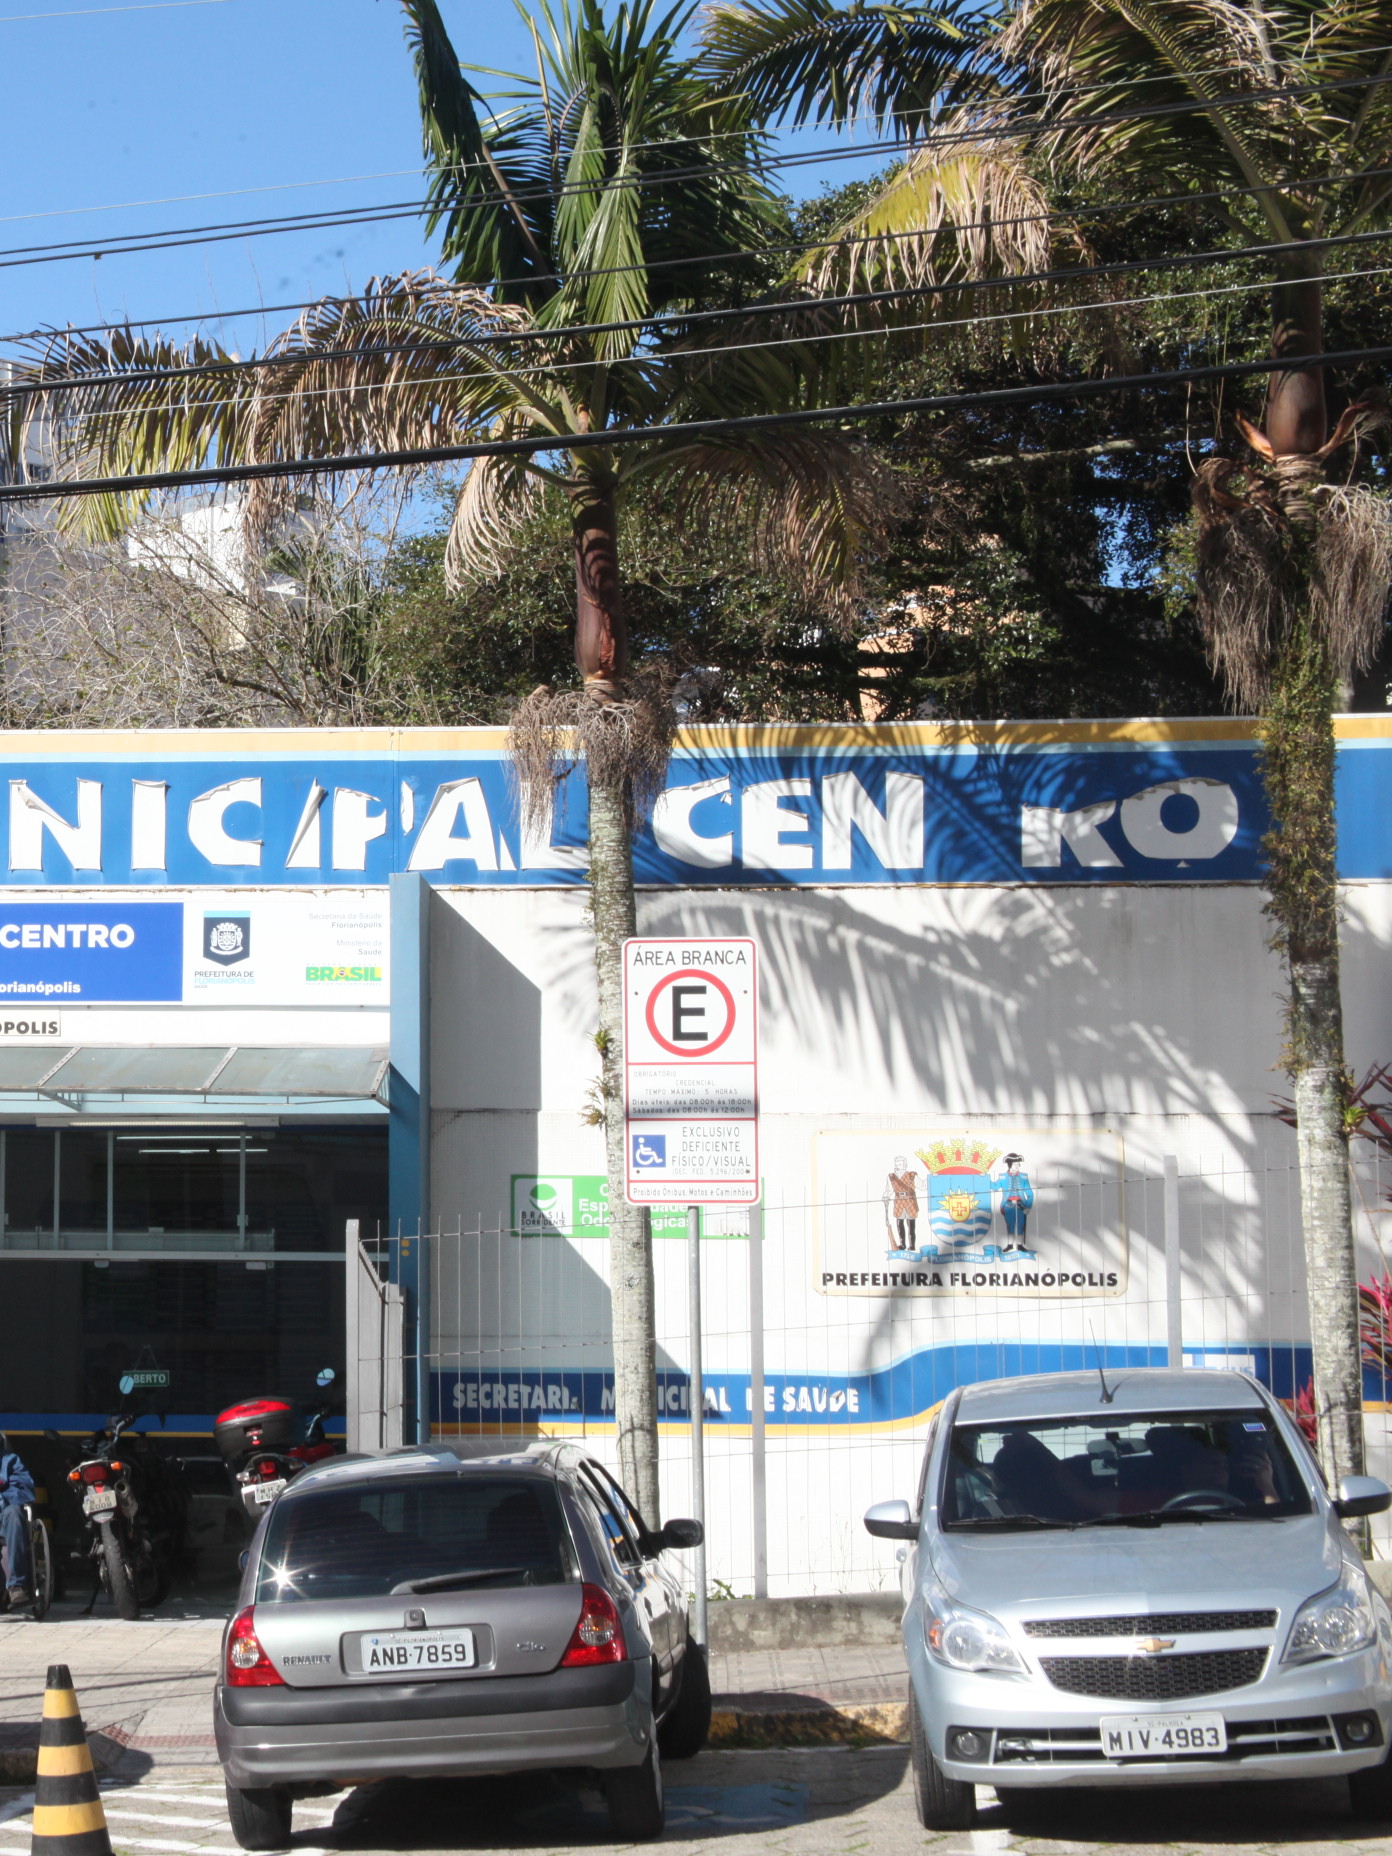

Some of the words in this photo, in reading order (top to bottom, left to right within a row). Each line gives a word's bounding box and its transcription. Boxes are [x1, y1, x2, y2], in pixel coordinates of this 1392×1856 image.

[652, 770, 1239, 870] CENRO
[331, 921, 383, 929] Florianópolis
[633, 945, 676, 966] ÁREA
[681, 950, 747, 966] BRANCA
[194, 970, 242, 978] PREFEITURA
[243, 970, 255, 978] DE
[305, 966, 382, 982] BRASIL
[672, 985, 708, 1041] E
[682, 1126, 740, 1138] EXCLUSIVO
[682, 1141, 741, 1152] DEFICIENTE
[672, 1153, 751, 1167] FÍSICO/VISUAL
[633, 1187, 661, 1197] Proibido
[689, 1187, 708, 1196] Motos
[715, 1187, 753, 1197] Caminhões
[521, 1211, 566, 1219] BRASIL
[822, 1271, 943, 1287] PREFEITURA
[949, 1267, 1119, 1287] FLORIANÓPOLIS
[127, 1373, 166, 1384] BERTO
[452, 1382, 580, 1410] SECRETARI
[600, 1383, 732, 1412] MICIAL
[282, 1654, 331, 1666] RENAULT
